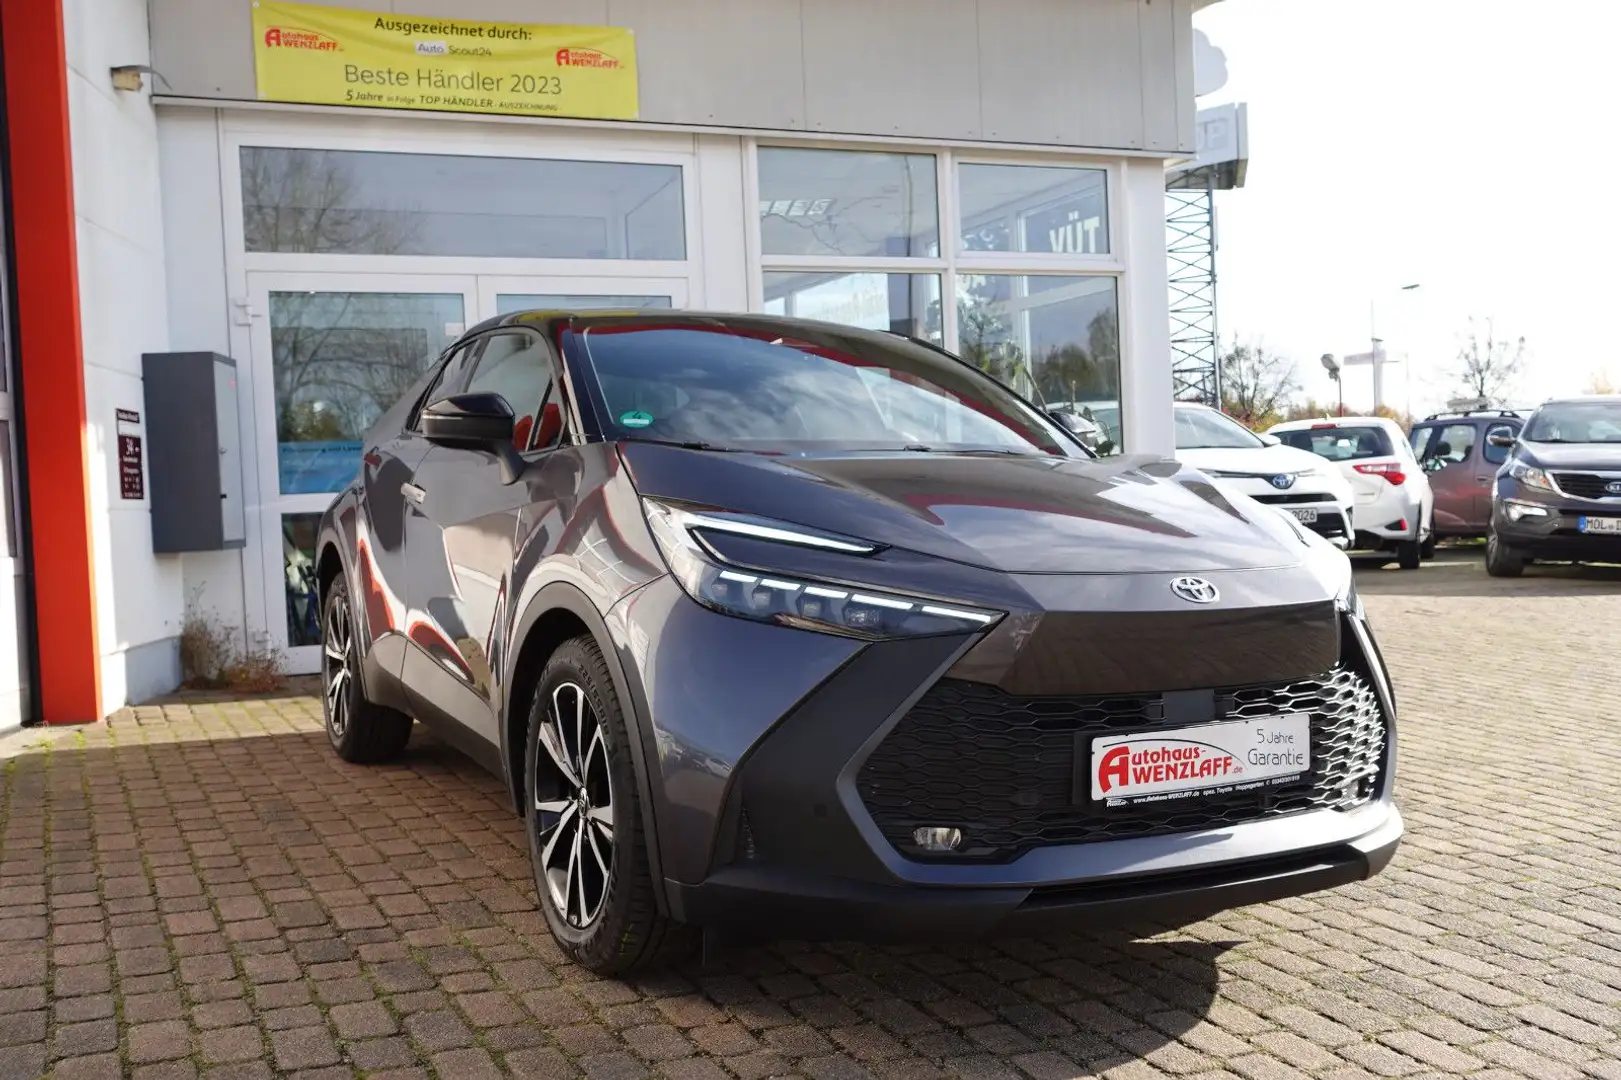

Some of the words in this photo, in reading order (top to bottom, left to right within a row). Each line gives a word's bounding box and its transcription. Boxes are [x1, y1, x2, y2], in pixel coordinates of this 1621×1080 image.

[374, 17, 484, 38] Ausgezeichnet
[488, 25, 532, 41] durch:
[283, 39, 338, 52] WENZLAFF
[418, 43, 445, 53] Auto
[449, 45, 492, 57] Scout24
[345, 64, 409, 86] Beste
[417, 68, 503, 91] Händler
[510, 74, 562, 95] 2023
[345, 88, 354, 101] 5
[355, 91, 384, 102] Jahre
[420, 95, 441, 105] TOP
[443, 96, 493, 108] HÄNDLER
[1586, 518, 1607, 530] MOL
[1256, 728, 1265, 744] 5
[1266, 730, 1294, 744] Jahre
[1248, 747, 1304, 767] Garantie
[1132, 755, 1233, 784] WENZLAFF
